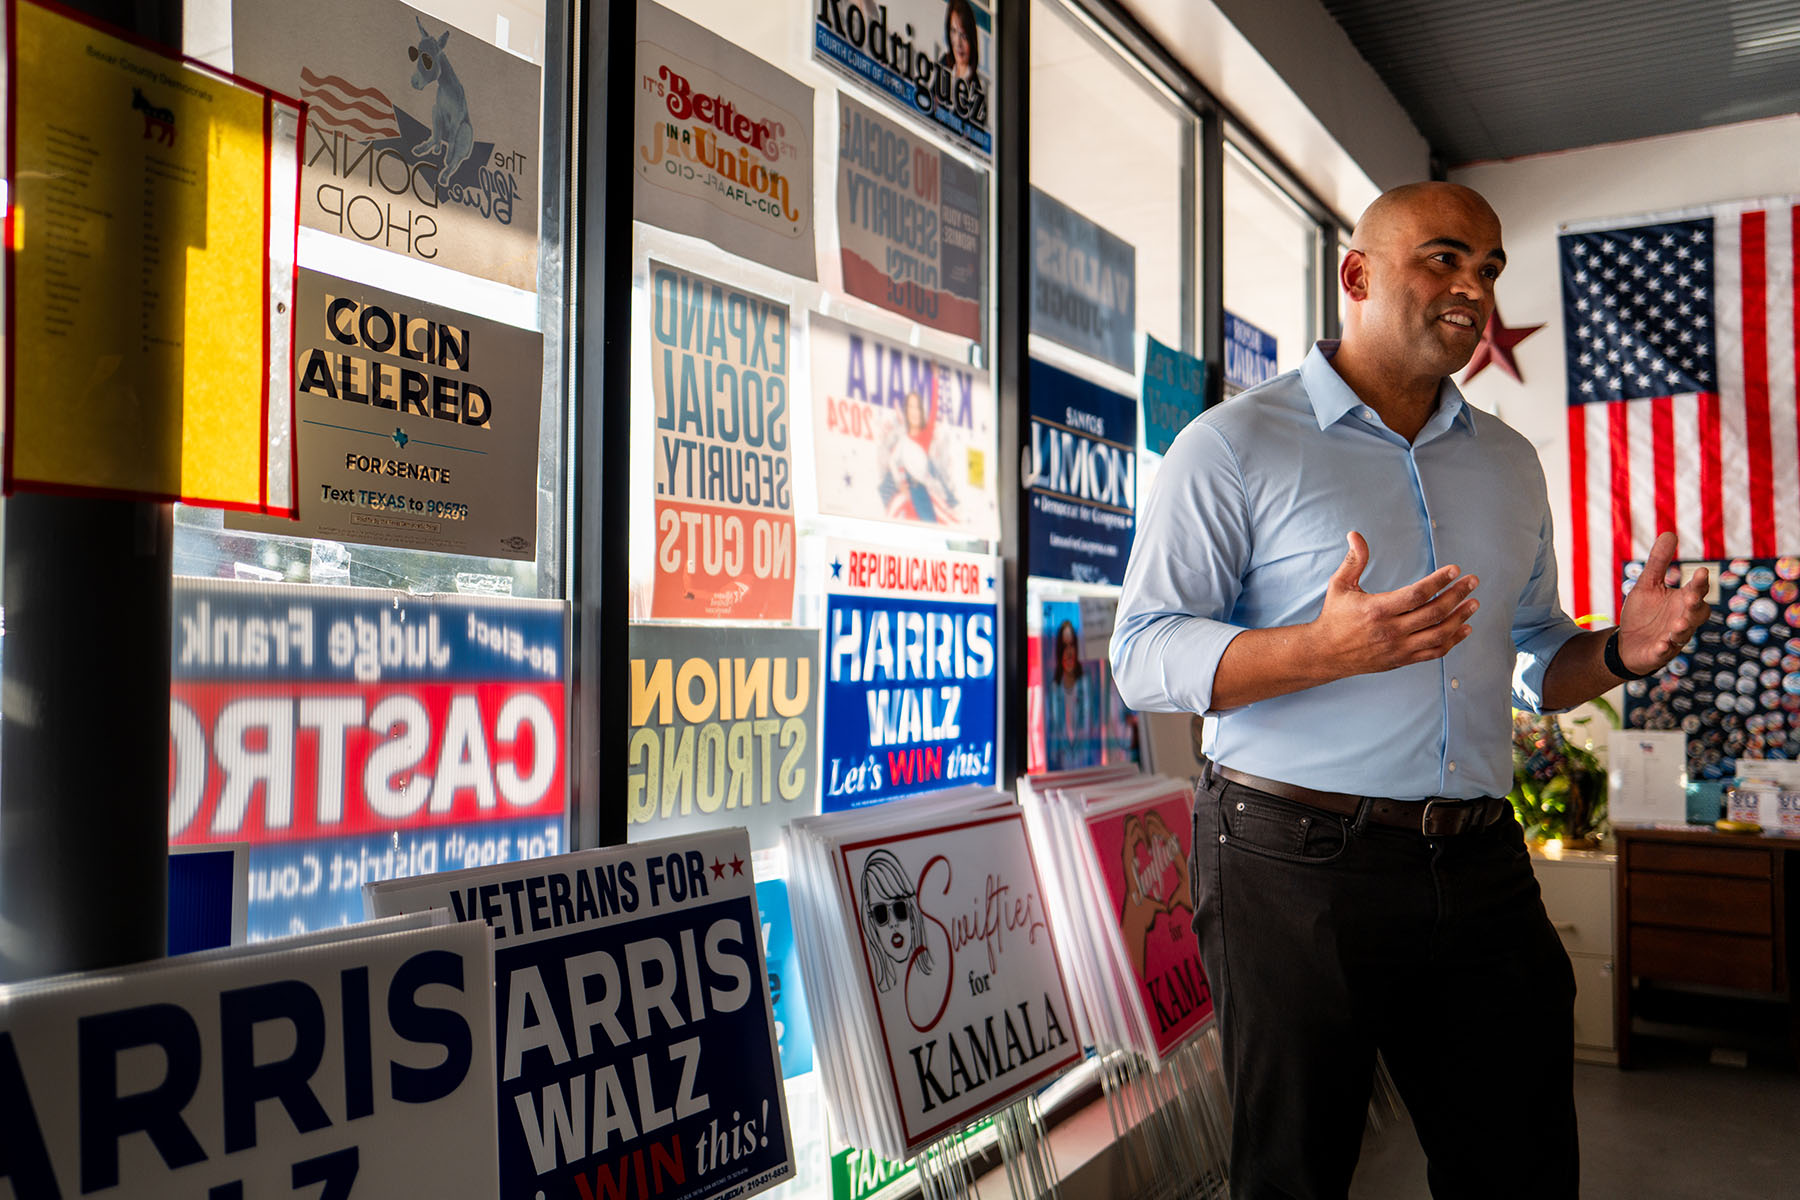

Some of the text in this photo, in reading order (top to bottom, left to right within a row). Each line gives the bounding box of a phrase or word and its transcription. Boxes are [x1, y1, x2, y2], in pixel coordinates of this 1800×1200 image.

[818, 29, 847, 59] FOURTH
[847, 48, 872, 73] COURT
[872, 64, 883, 81] OF
[643, 75, 666, 98] IT'S
[659, 64, 770, 151] Better
[666, 122, 799, 222] IN A Union
[724, 185, 781, 218] AFL-CIO
[327, 297, 470, 373] COLIN
[299, 348, 492, 427] ALLRED
[1066, 406, 1105, 436] SANTOS
[321, 484, 355, 504] Text
[358, 489, 405, 510] TEXAS
[409, 497, 424, 512] to
[346, 453, 450, 484] FOR SENATE
[848, 550, 980, 596] REPUBLICANS FOR
[830, 608, 994, 682] HARRIS
[866, 686, 961, 747] WALZ
[827, 741, 992, 796] Let's WIN this!
[450, 850, 709, 941] VETERANS FOR
[905, 855, 1044, 1033] Swifties
[503, 918, 751, 1082] ARRIS
[968, 970, 991, 997] for
[1146, 954, 1213, 1034] KAMA
[0, 950, 473, 1200] RRIS
[909, 992, 1068, 1114] KAMALA
[513, 1036, 711, 1176] WALZ
[573, 1134, 687, 1200] WIN
[695, 1098, 770, 1176] this!
[846, 1148, 886, 1200] TAX
